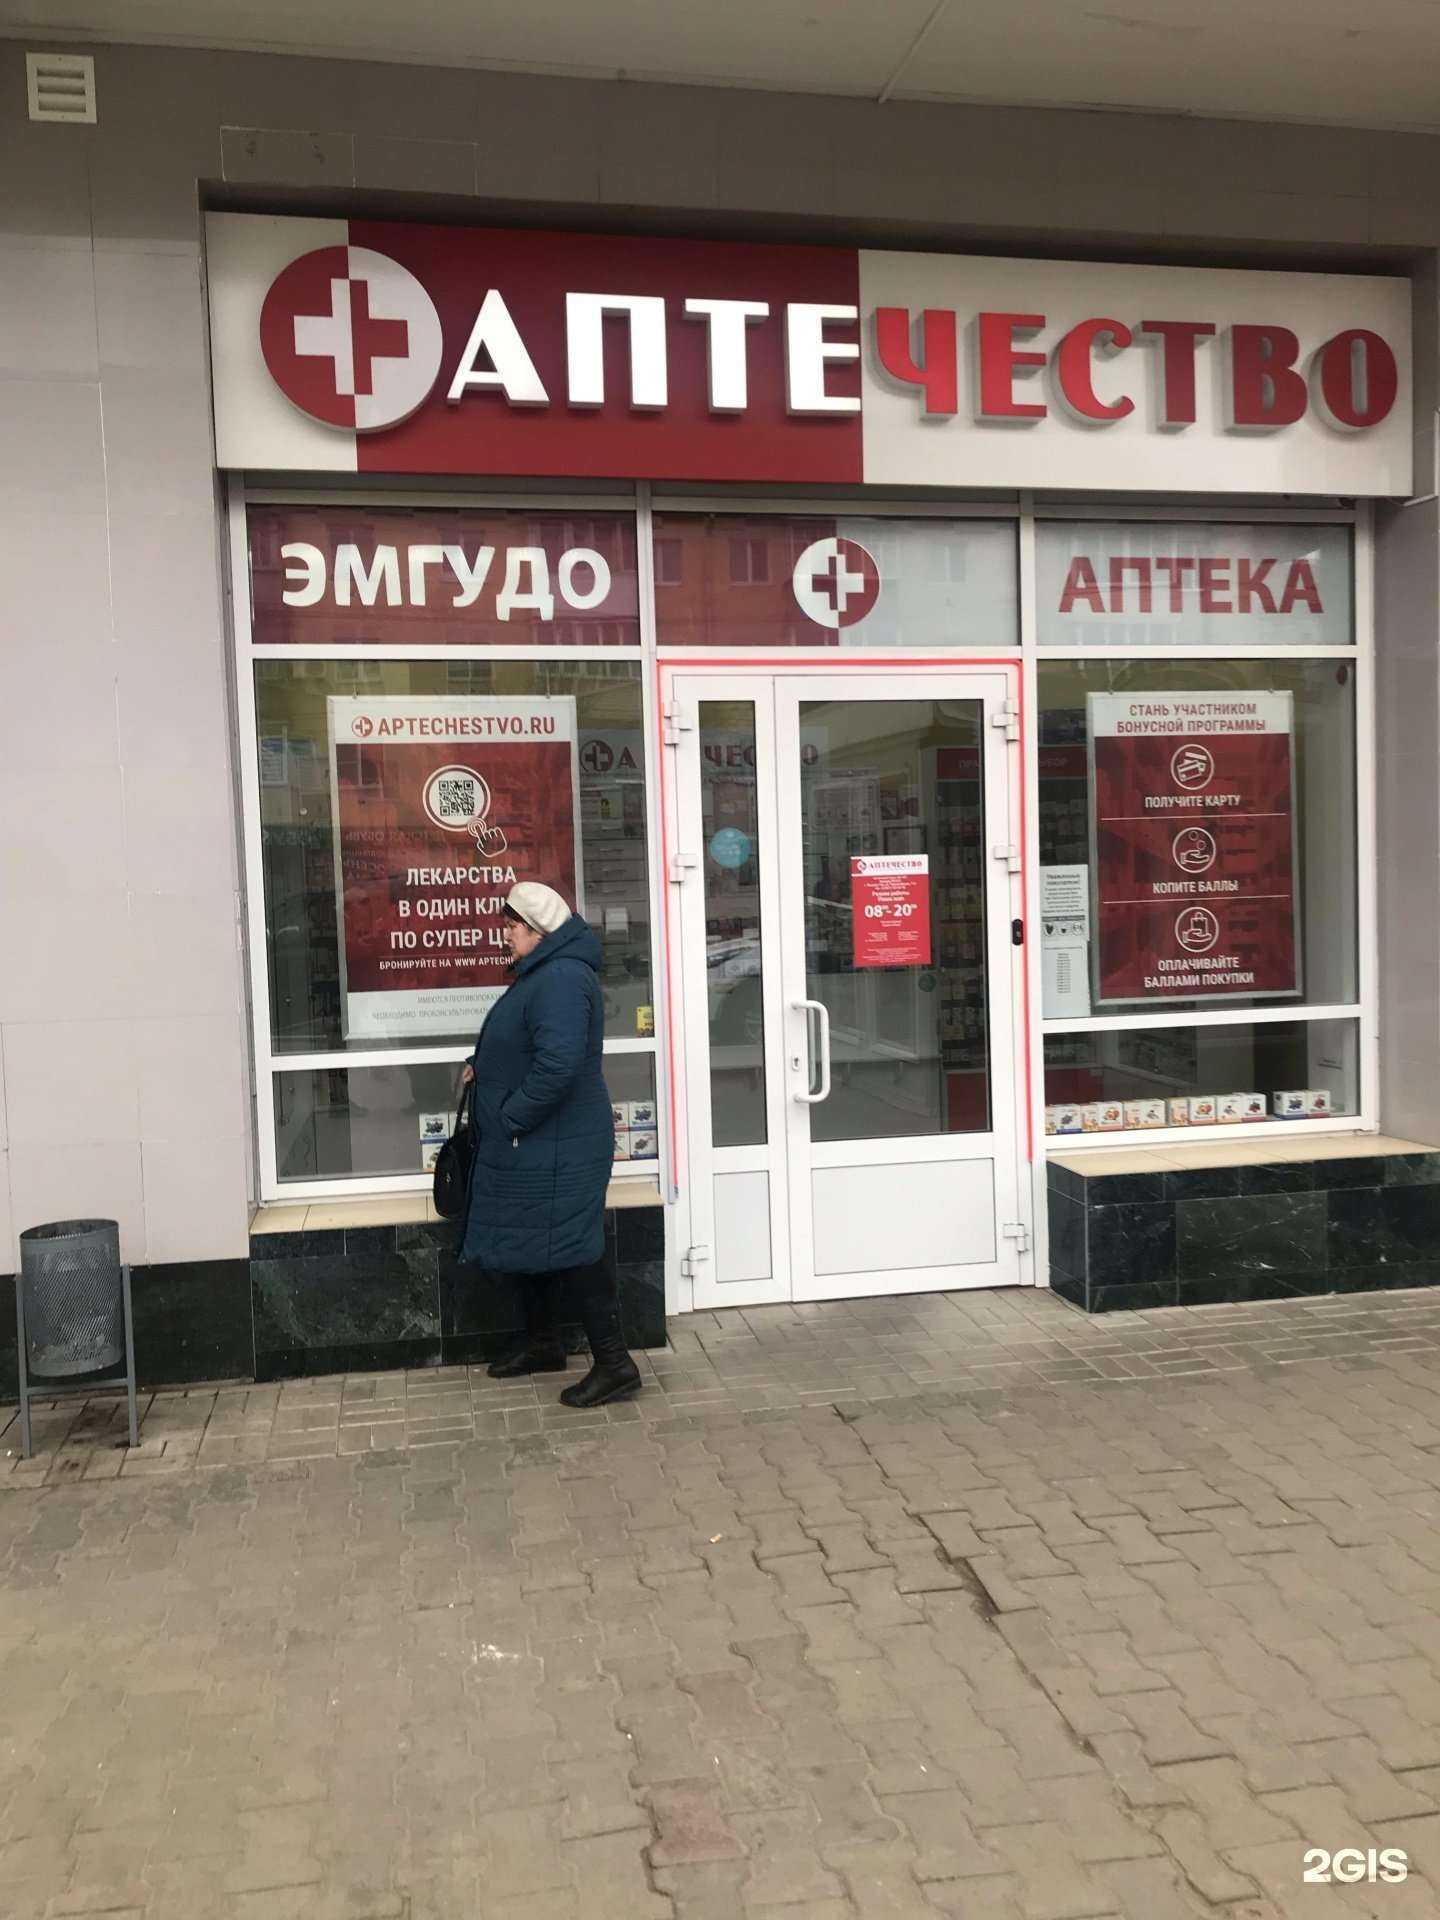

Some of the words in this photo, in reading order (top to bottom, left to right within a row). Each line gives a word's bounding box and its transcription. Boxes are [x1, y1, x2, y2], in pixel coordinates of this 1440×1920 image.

[447, 289, 1398, 428] АПТЕЧЕСТВО
[280, 543, 612, 622] ЭМГУДО
[1058, 556, 1323, 615] АПТЕКА
[1129, 704, 1169, 717] СТАНЬ
[1173, 703, 1257, 716] УЧАСТНИКОМ
[377, 716, 556, 737] APTECHESTVO.RU
[1116, 718, 1184, 734] БОНУСНОЙ
[1187, 719, 1266, 733] ПРОГРАММЫ
[1144, 796, 1203, 809] ПОЛУЧИТЕ
[1205, 795, 1241, 807] КАРТУ
[405, 866, 517, 887] ЛЕКАРСТВА
[1152, 881, 1197, 894] КОПИТЕ
[1198, 880, 1240, 892] БАЛЛЫ
[398, 900, 411, 918] В
[416, 898, 470, 920] ОДИН
[390, 931, 417, 950] ПО
[422, 928, 483, 948] СУПЕР
[379, 958, 438, 970] БРОНИРУЙТЕ
[439, 957, 451, 968] НА
[1158, 955, 1240, 971] ОПЛАЧИВАЙТЕ
[1144, 974, 1200, 988] БАЛЛАМИ
[1202, 972, 1255, 986] ПОКУПКИ
